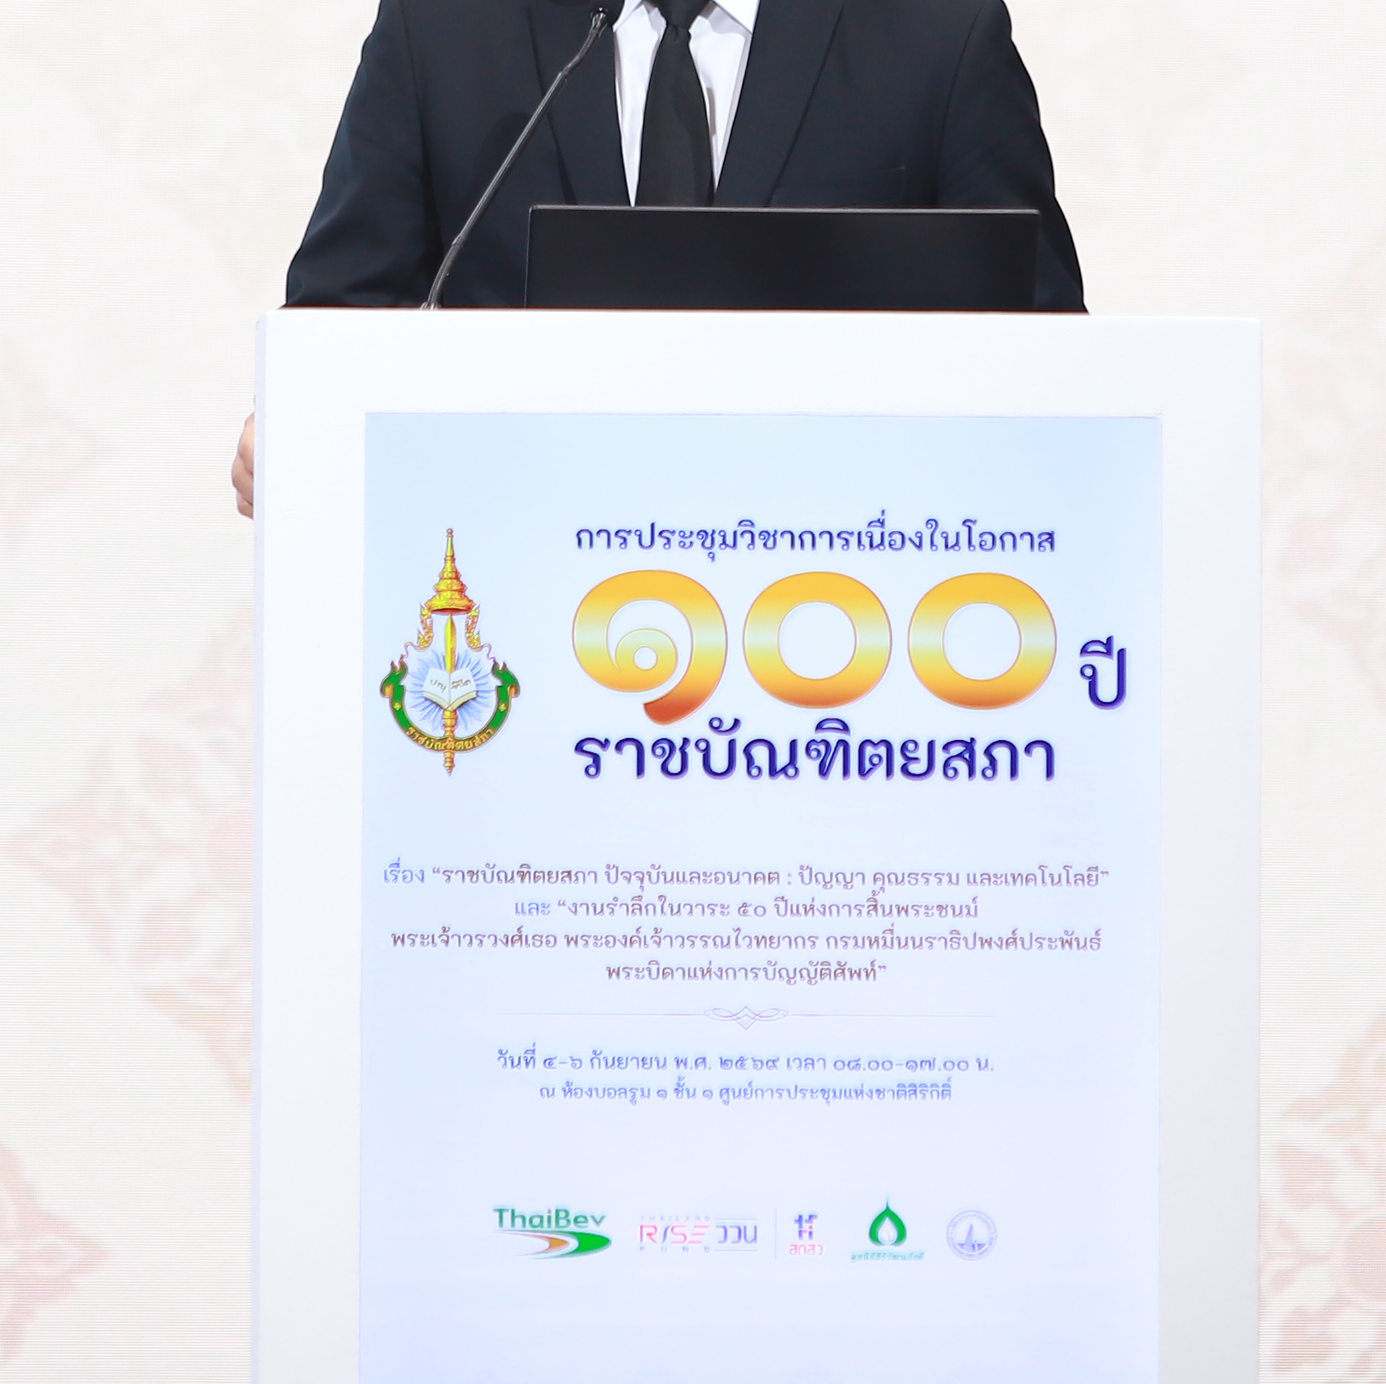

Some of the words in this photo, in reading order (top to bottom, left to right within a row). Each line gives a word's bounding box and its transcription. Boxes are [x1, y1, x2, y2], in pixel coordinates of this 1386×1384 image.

[576, 509, 1055, 562] การประชุมวิชาการเนื่องในโอกาส
[571, 569, 1058, 725] ๑๐๐
[1080, 636, 1126, 709] ปี
[573, 716, 1057, 781] ราชบัณฑิตยสภา
[383, 856, 425, 884] เรื่อง
[604, 863, 781, 893] ปัจจุบันและอนาคต
[798, 864, 866, 891] ปัญญา
[872, 871, 961, 895] คุณธรรม
[514, 901, 551, 916] และ
[737, 901, 767, 918] ๕๐
[772, 888, 979, 919] ปีแห่งการสิ้นพระชนม์
[390, 924, 558, 949] พระเจ้าวรวงศ์เธอ
[563, 925, 820, 950] พระองค์เจ้าวรรณไวทยากร
[825, 922, 1102, 951] กรมหมื่นนราธิปพงศ์ประพันธ์
[497, 1041, 536, 1070] วันที่
[589, 1049, 667, 1070] กันยายน
[673, 1056, 712, 1070] พ.ศ.
[786, 1056, 827, 1071] เวลา
[975, 1057, 994, 1072] น.
[539, 1086, 556, 1099] ณ
[560, 1080, 651, 1106] ห้องบอลรูม
[672, 1075, 697, 1100] ชั้น
[718, 1076, 952, 1106] ศูนย์การประชุมแห่งชาติสิริกิติ์
[492, 1207, 607, 1230] ThaiBev
[716, 1225, 758, 1244] ววน
[788, 1243, 824, 1256] สกสว
